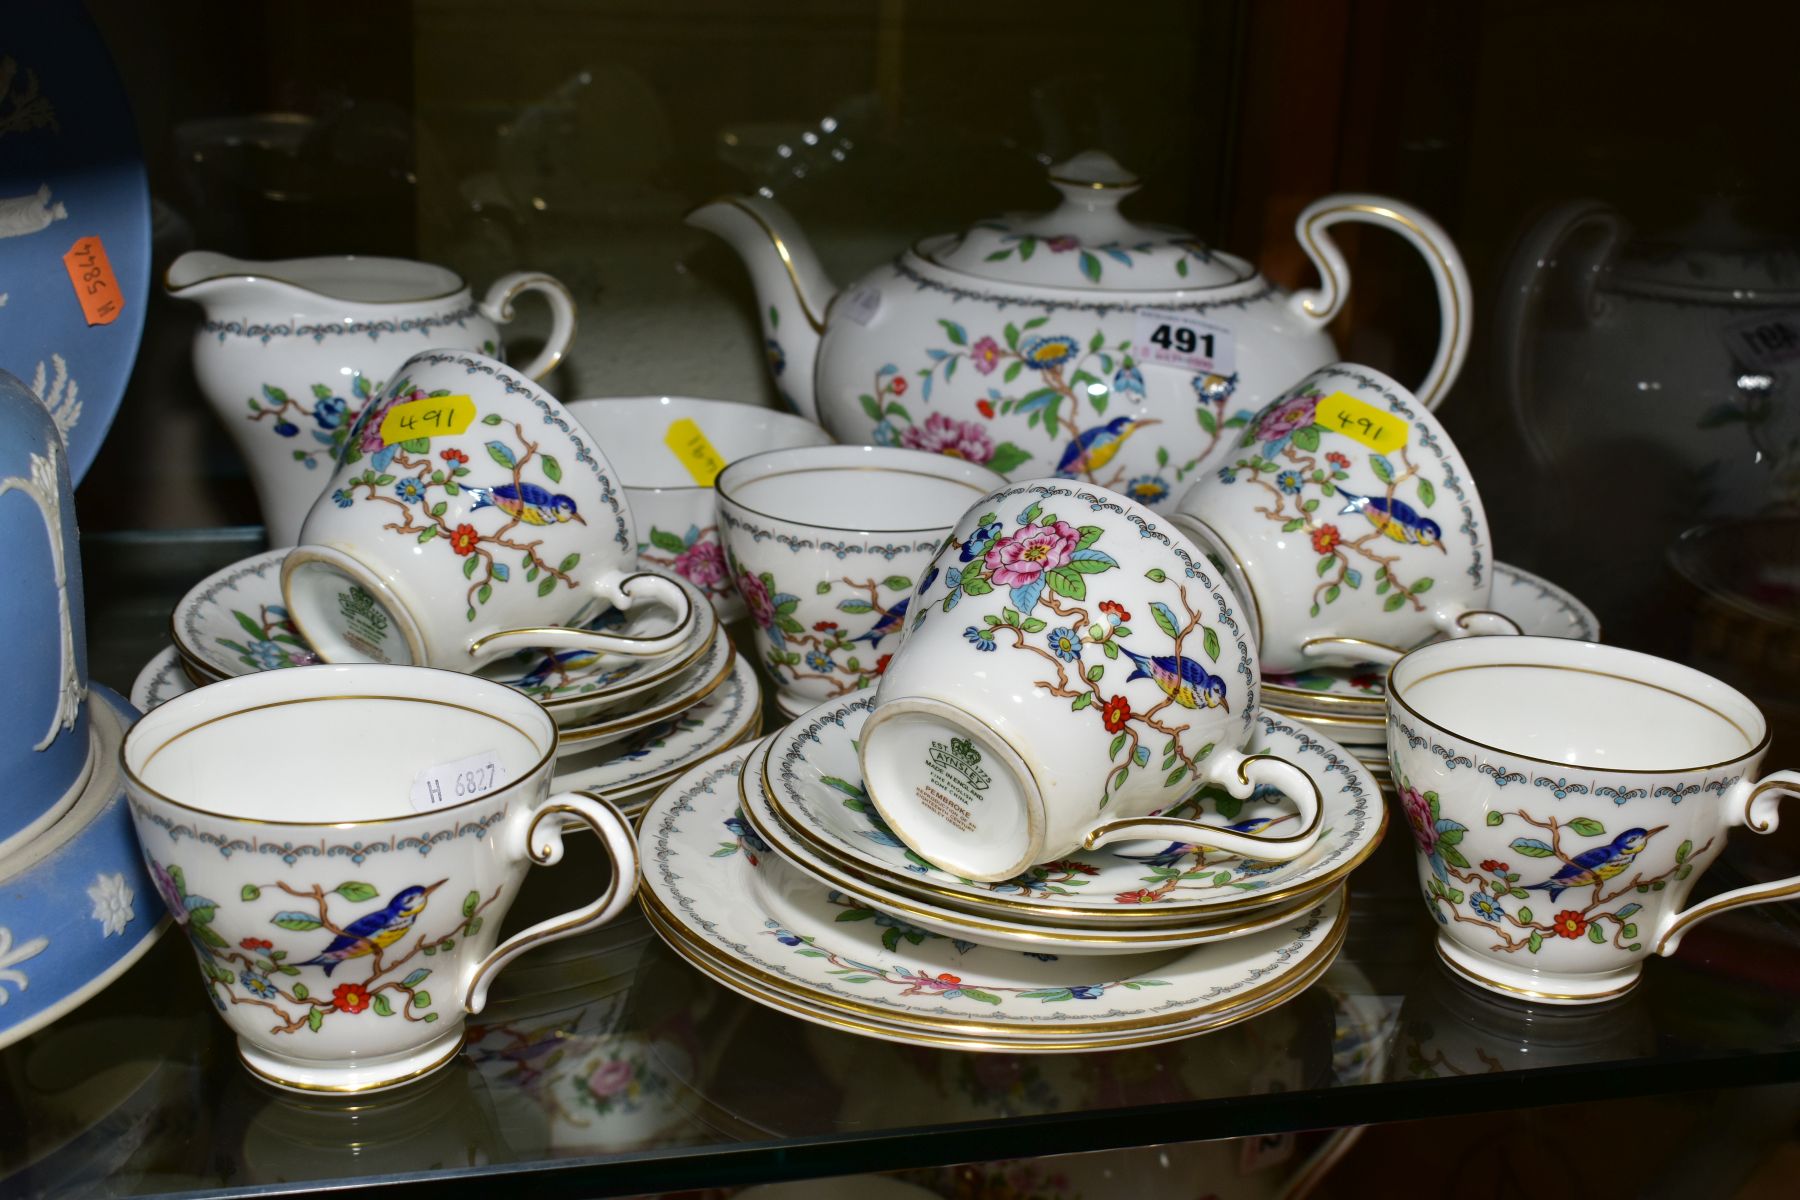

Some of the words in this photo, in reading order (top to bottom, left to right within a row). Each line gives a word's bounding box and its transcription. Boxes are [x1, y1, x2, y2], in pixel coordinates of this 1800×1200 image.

[74, 244, 107, 295] 5844
[1150, 324, 1214, 358] 491
[400, 408, 454, 430] 491
[1337, 411, 1383, 440] 491
[427, 779, 442, 803] H
[455, 763, 495, 797] 6827
[925, 759, 944, 774] MADE
[945, 772, 953, 780] IN
[953, 777, 984, 801] ENGLAND
[937, 752, 983, 783] AYNSLEY
[974, 765, 992, 783] 1775
[925, 785, 971, 818] PEMBROKE
[931, 778, 947, 790] BONE
[949, 790, 969, 805] CHINA
[947, 781, 973, 802] ENGLISH
